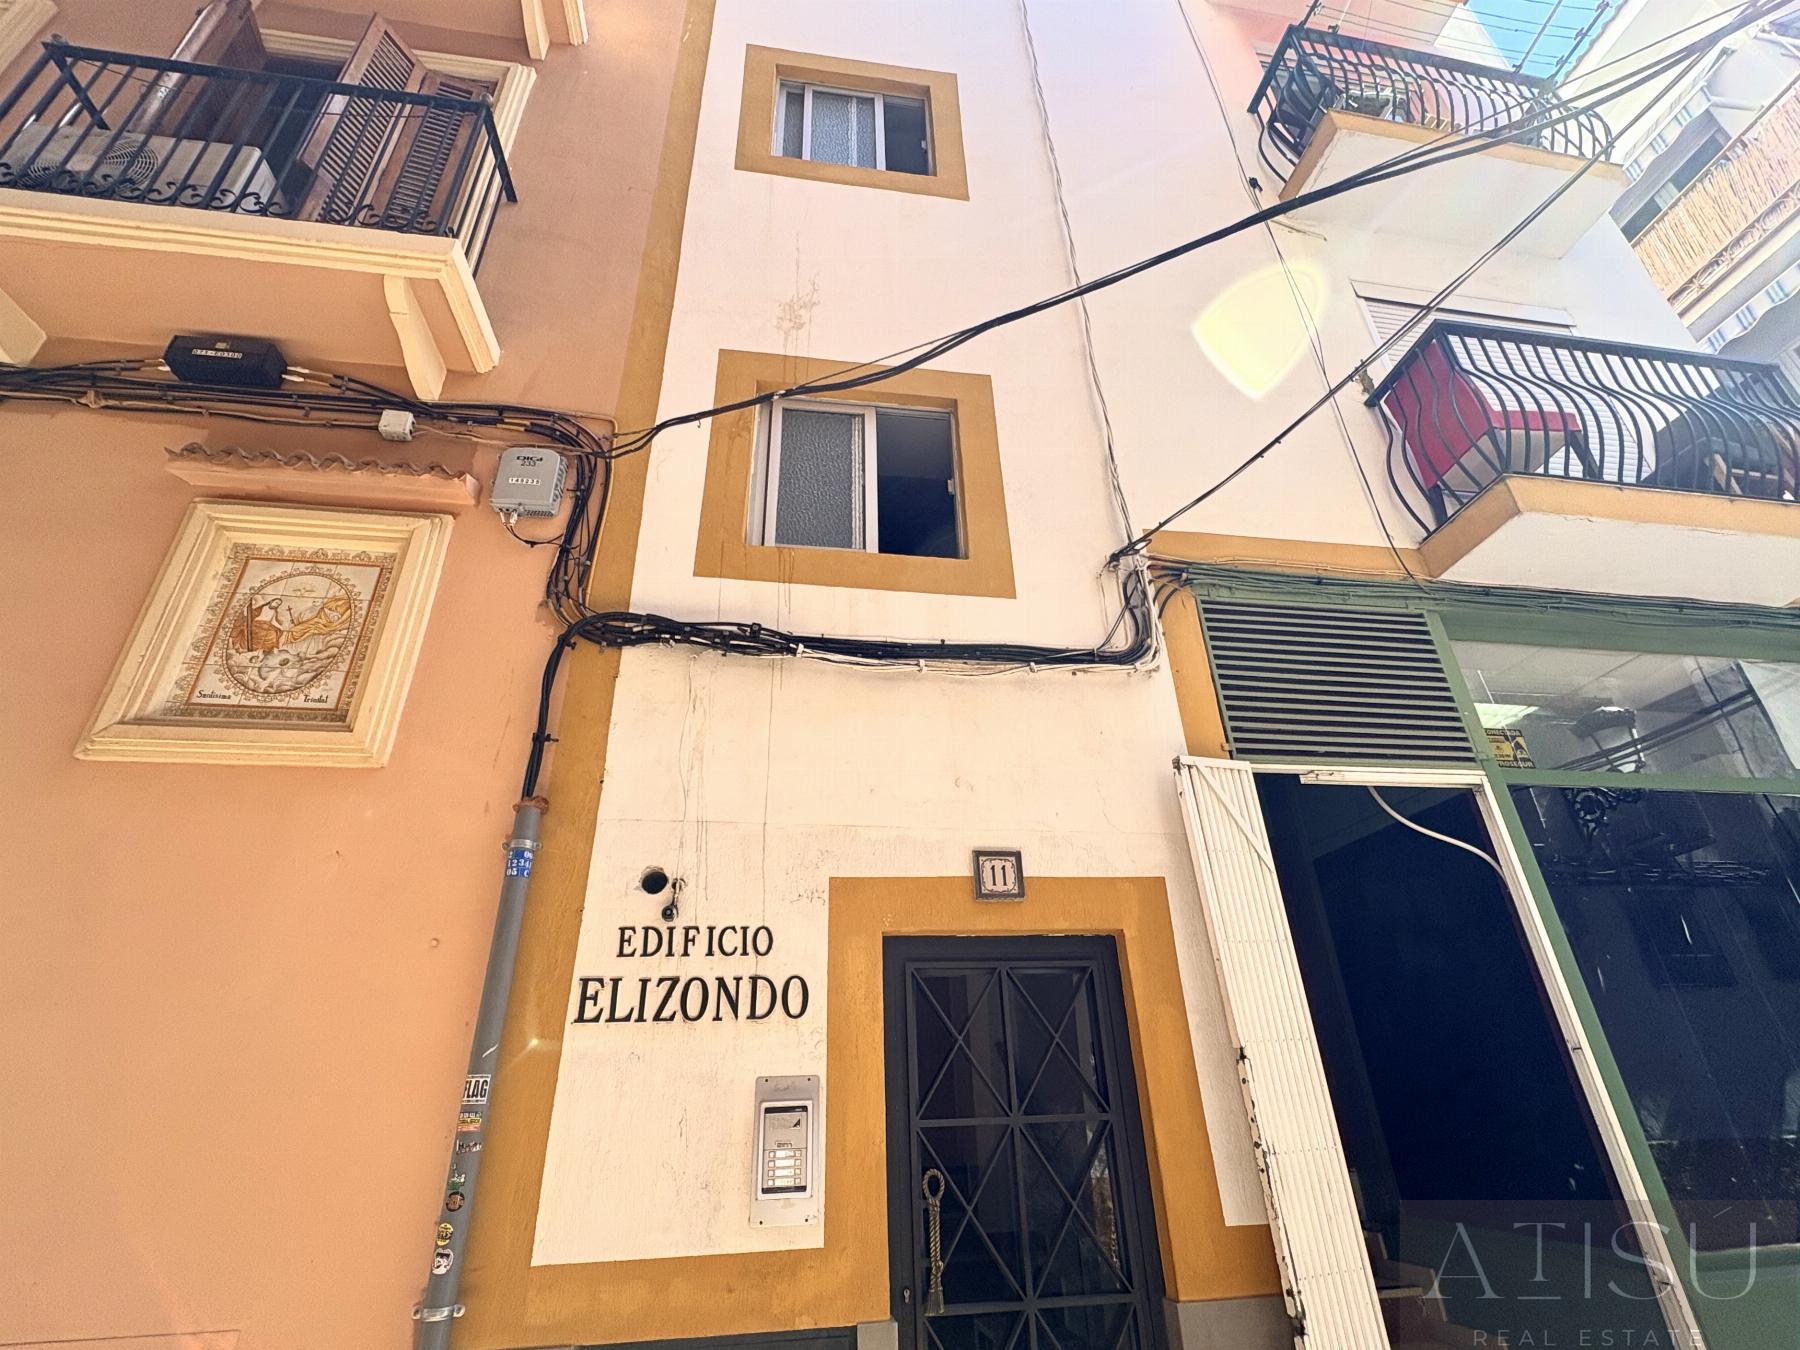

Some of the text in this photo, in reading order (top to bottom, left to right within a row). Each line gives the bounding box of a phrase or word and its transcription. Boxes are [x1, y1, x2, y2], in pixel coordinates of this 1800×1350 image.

[990, 864, 1008, 887] 11
[616, 925, 774, 958] EDIFICIO
[572, 974, 810, 1024] ELIZONDO
